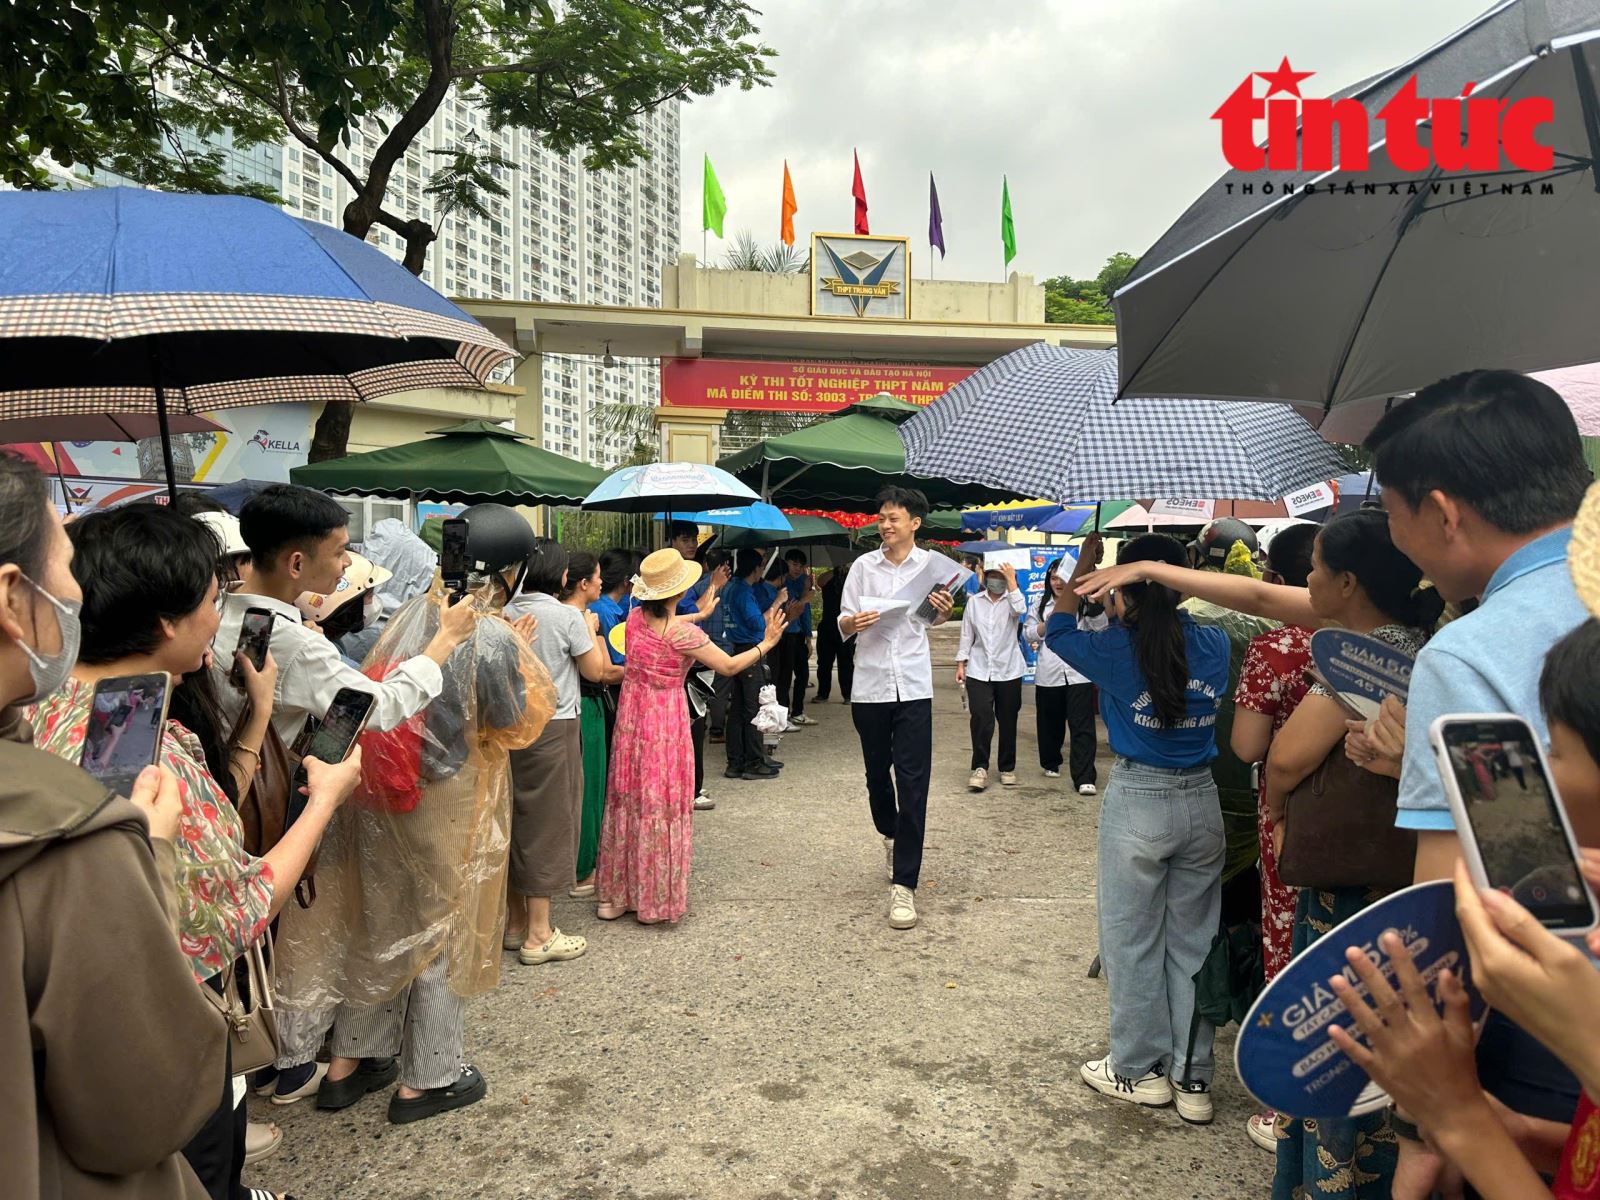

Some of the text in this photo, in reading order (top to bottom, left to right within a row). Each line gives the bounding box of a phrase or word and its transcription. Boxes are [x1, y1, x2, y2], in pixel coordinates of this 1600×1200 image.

[739, 374, 758, 386] KỲ
[762, 376, 785, 387] THI
[789, 373, 814, 388] TỐT
[818, 377, 870, 392] NGHIỆP
[874, 379, 908, 391] THPT
[911, 379, 944, 392] NĂM
[706, 386, 728, 399] MÃ
[731, 385, 765, 400] ĐIỂM
[768, 390, 788, 401] THI
[791, 388, 812, 402] SỐ:
[815, 391, 846, 402] 3003
[268, 440, 300, 451] KELLA
[1354, 678, 1375, 693] 45
